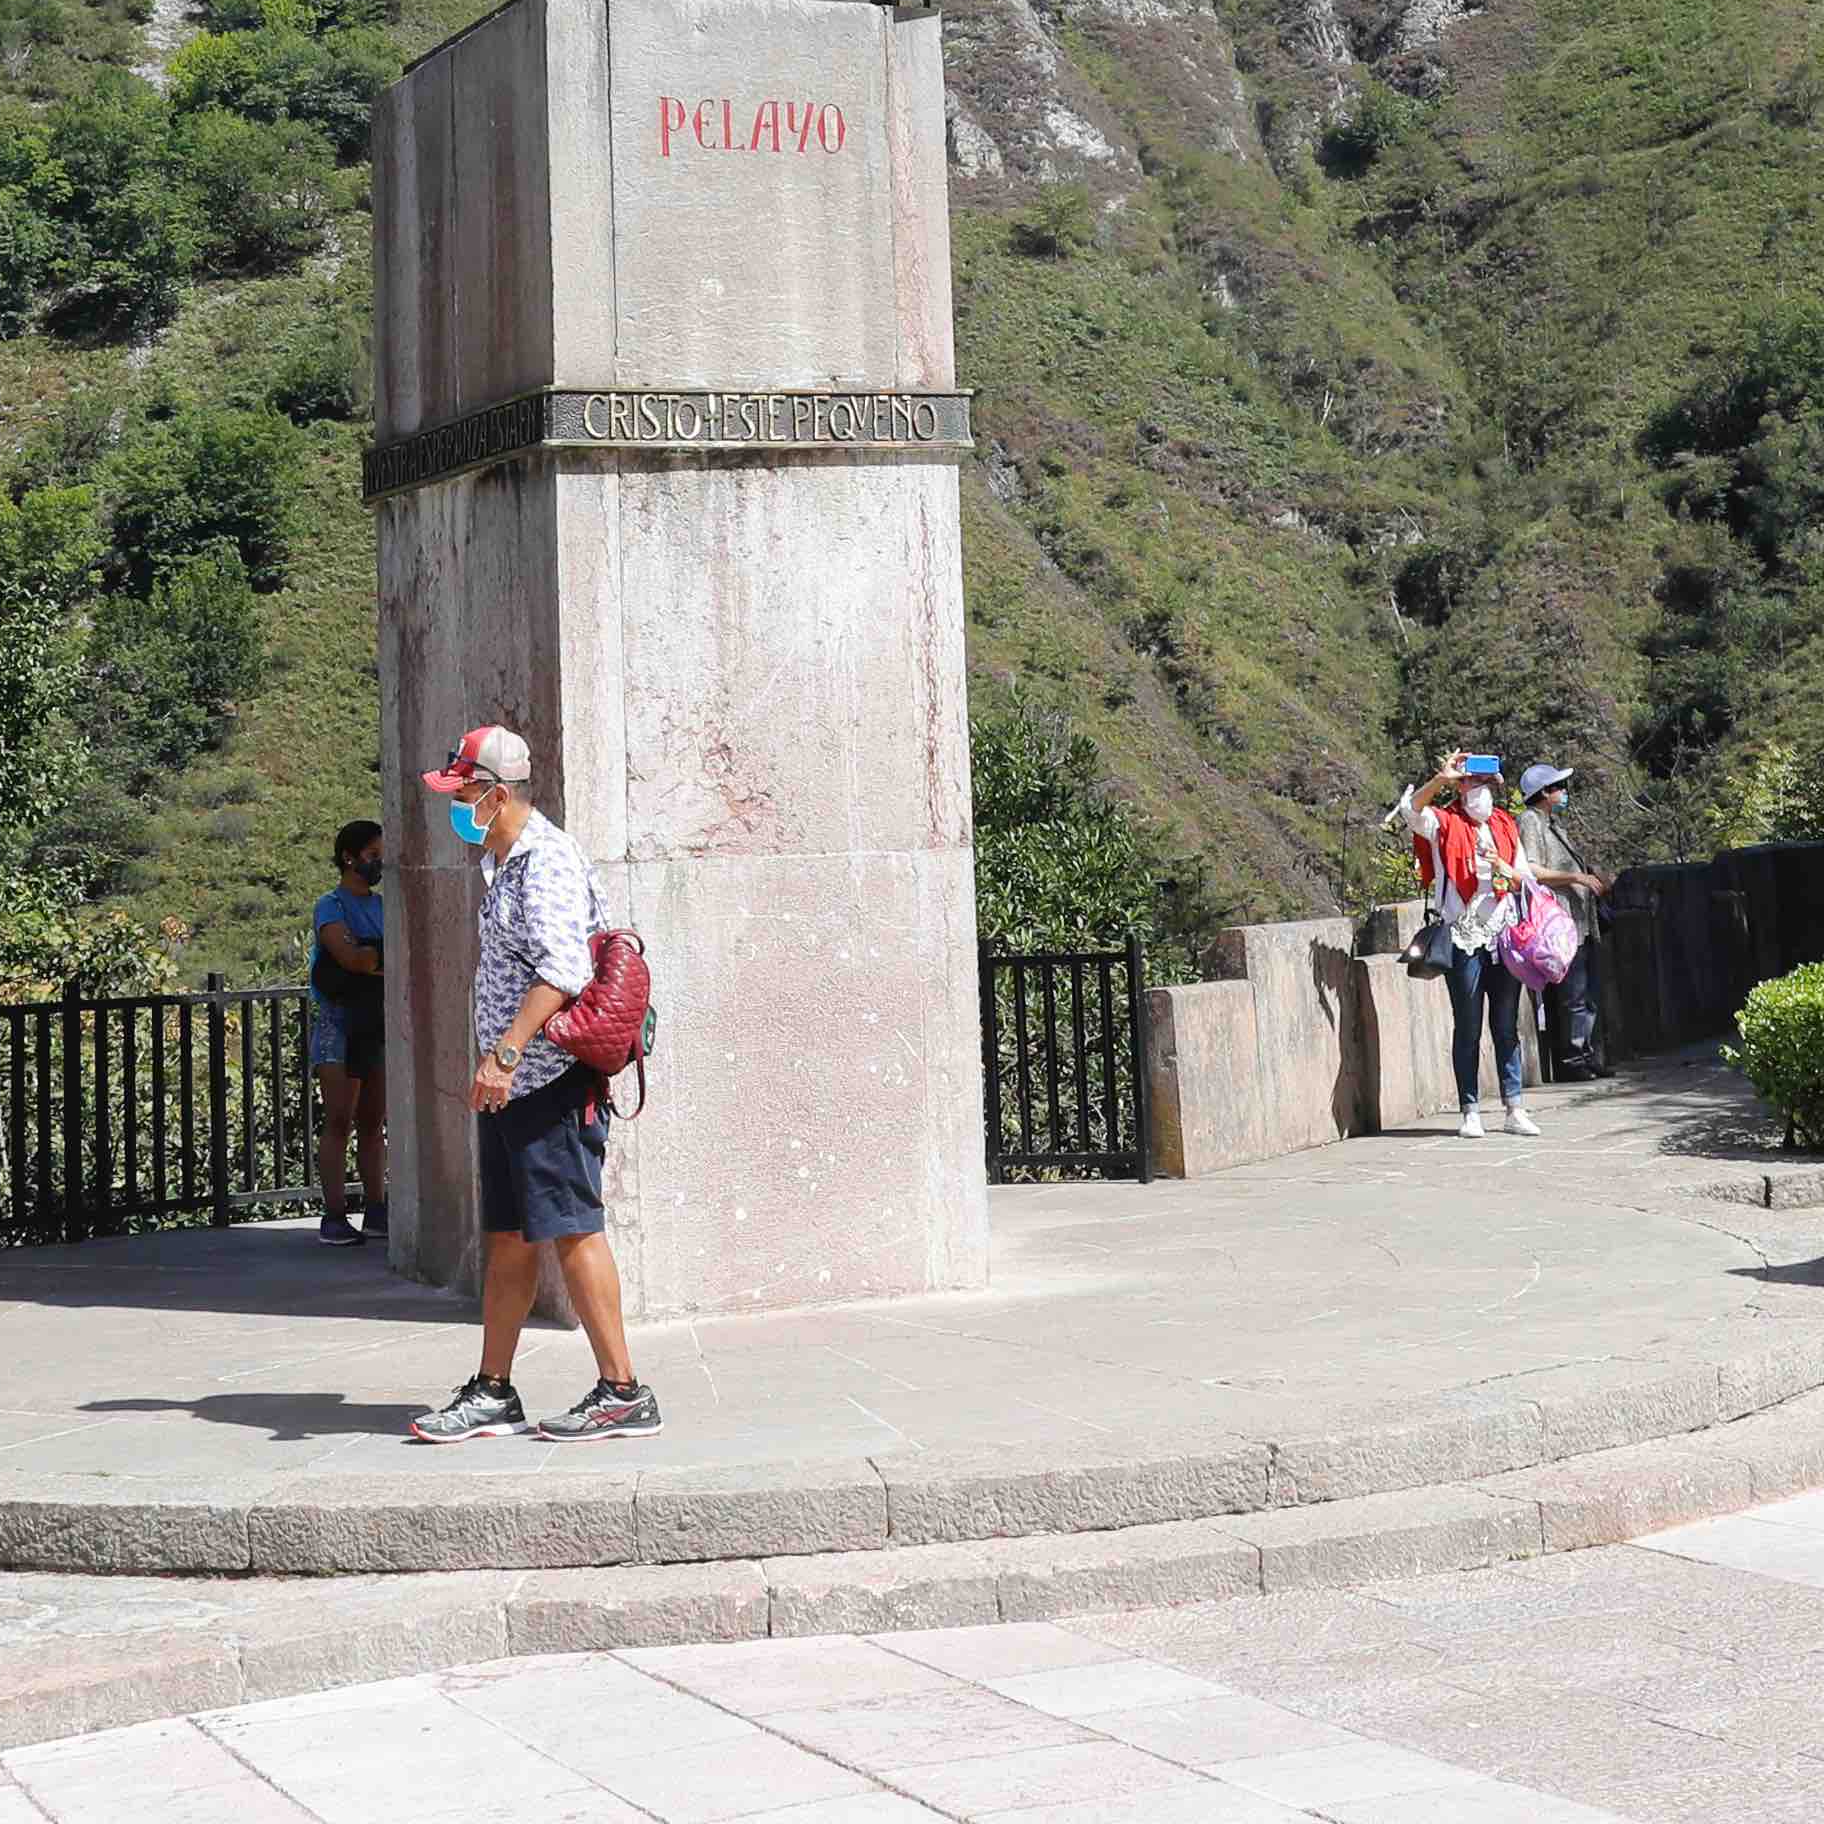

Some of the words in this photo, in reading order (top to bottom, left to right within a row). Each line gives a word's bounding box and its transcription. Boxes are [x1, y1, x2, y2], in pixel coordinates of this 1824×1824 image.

[659, 95, 846, 158] PELAYO
[583, 393, 701, 440] CRISTO
[722, 394, 786, 440] ESTE
